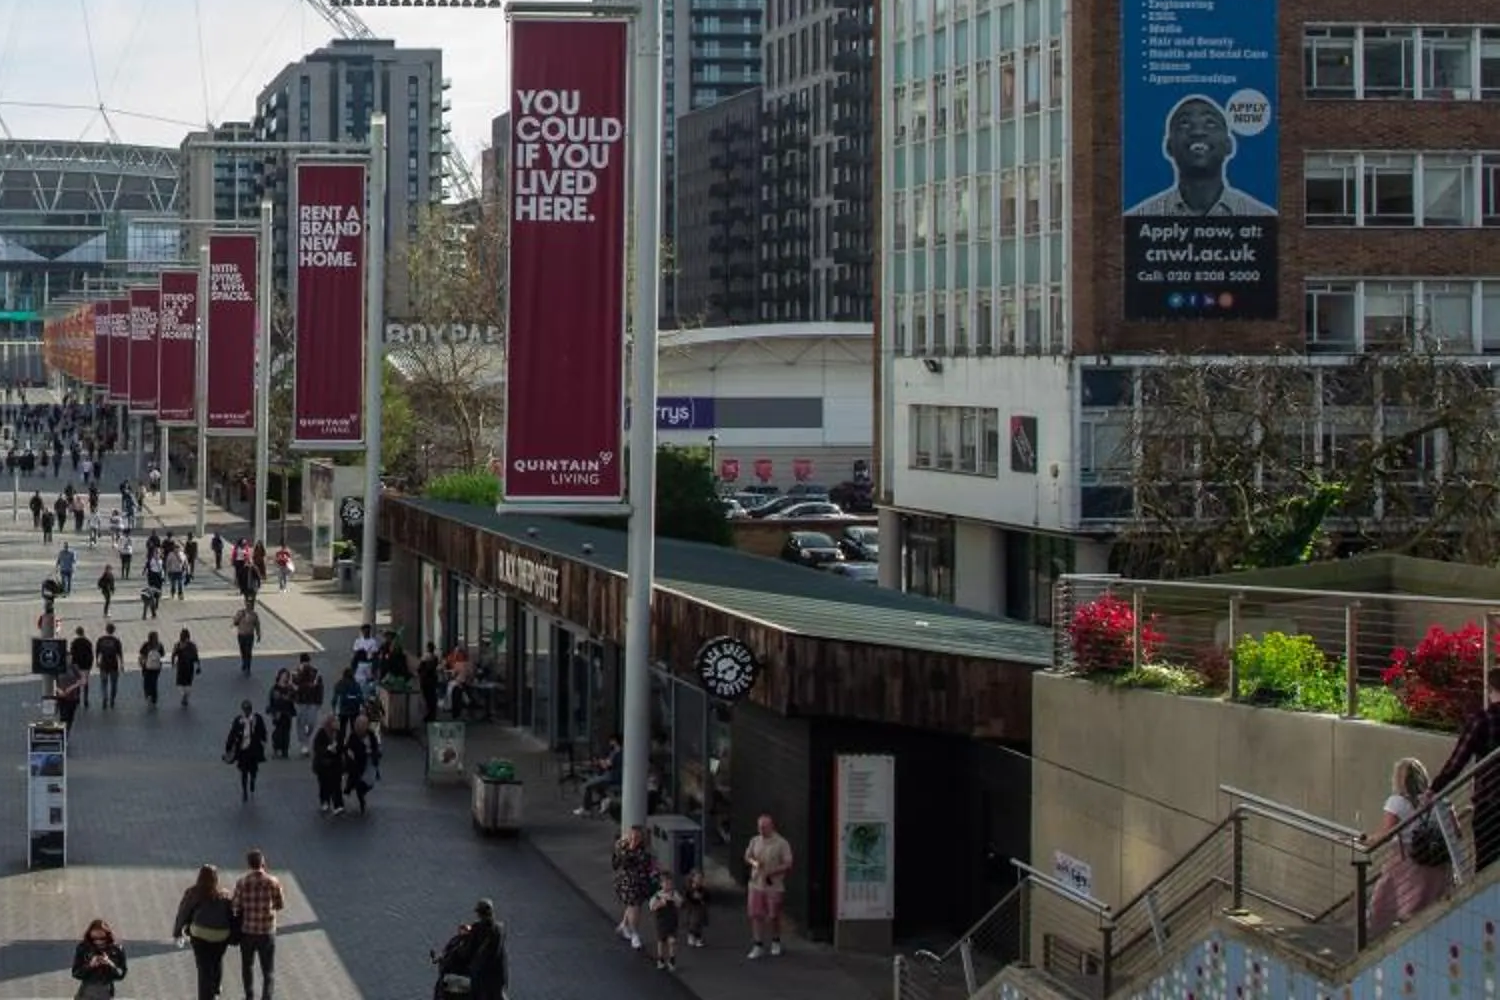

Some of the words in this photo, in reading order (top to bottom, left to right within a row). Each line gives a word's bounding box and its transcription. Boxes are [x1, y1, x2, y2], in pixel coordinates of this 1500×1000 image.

[1149, 36, 1171, 46] Hair
[1174, 36, 1195, 46] and
[1149, 49, 1185, 59] Health
[1186, 49, 1207, 59] and
[1209, 49, 1242, 59] Social
[1244, 49, 1269, 59] Care
[516, 89, 580, 115] YOU
[1230, 103, 1268, 113] APPLY
[1234, 113, 1263, 123] NOW
[516, 116, 622, 142] COULD
[516, 143, 540, 169] IF
[546, 143, 609, 169] YOU
[516, 169, 597, 195] LIVED
[300, 205, 342, 220] RENT
[346, 205, 360, 221] A
[515, 195, 595, 222] HERE.
[300, 221, 361, 236] BRAND
[1139, 223, 1189, 242] Apply
[1194, 226, 1234, 239] now,
[1239, 225, 1263, 237] at:
[300, 236, 339, 251] NEW
[300, 251, 357, 267] HOME.
[1145, 243, 1256, 262] cnwl.ac.uk
[1167, 271, 1191, 281] 020
[514, 460, 599, 473] QUINTAIN
[551, 473, 600, 485] LIVING
